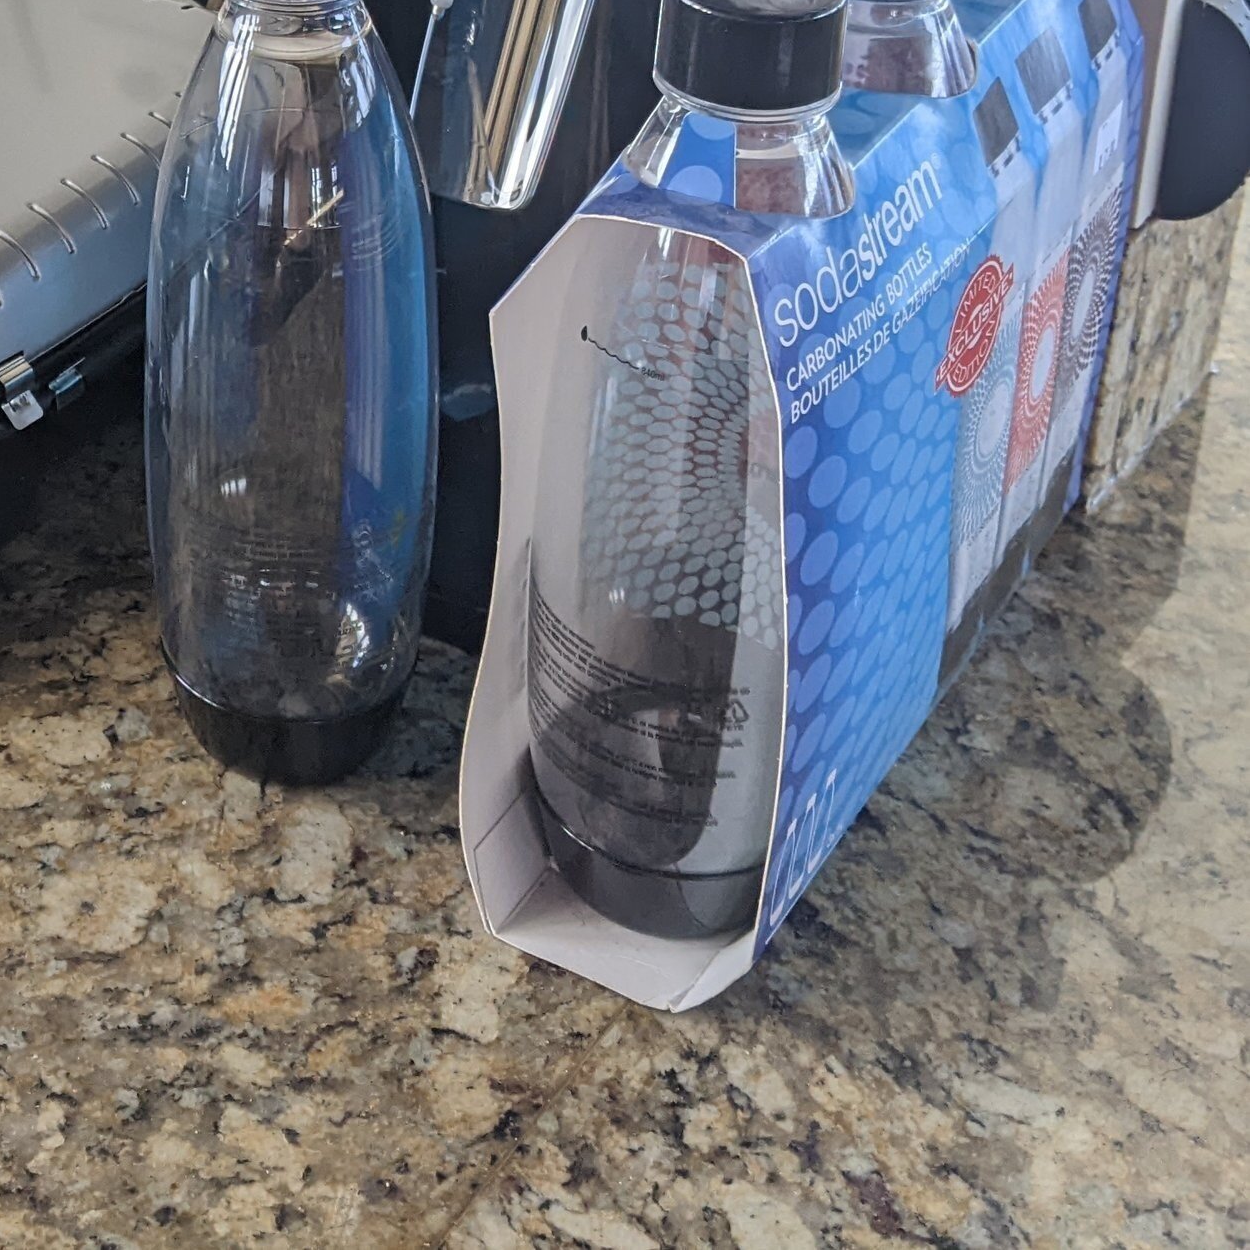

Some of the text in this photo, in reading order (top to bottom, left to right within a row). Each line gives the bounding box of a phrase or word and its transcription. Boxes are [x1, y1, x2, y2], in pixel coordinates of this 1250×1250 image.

[786, 241, 933, 392] CARBONATING BOTTLES
[939, 275, 1010, 379] EXCLUSIVE
[955, 271, 997, 334] LIMITED
[790, 345, 873, 424] BOUTEILLES
[872, 328, 890, 356] DE
[952, 320, 996, 384] EDITION
